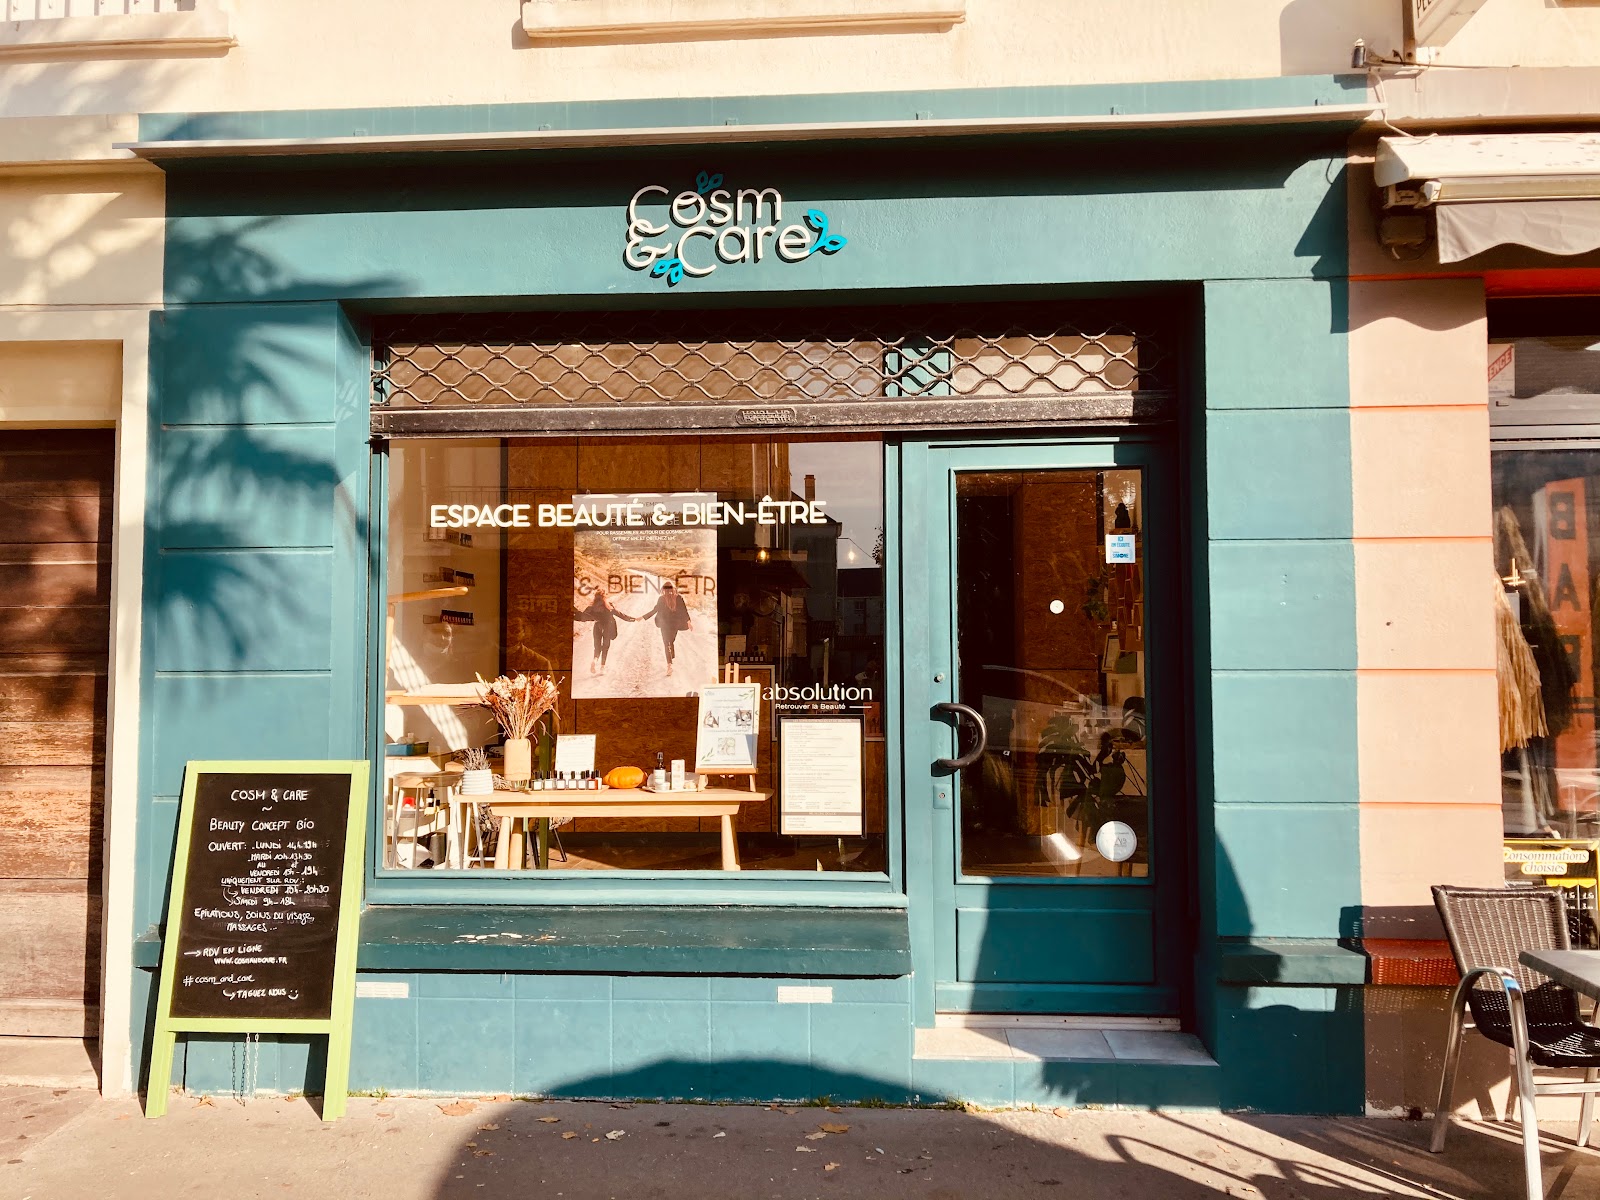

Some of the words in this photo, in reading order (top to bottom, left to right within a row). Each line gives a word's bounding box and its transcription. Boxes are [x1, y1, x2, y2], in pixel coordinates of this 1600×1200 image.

[630, 185, 782, 233] Cosm
[625, 218, 672, 267] &
[677, 224, 811, 275] Care
[430, 503, 531, 528] ESPACE
[538, 497, 646, 528] BEAUTÉ
[652, 503, 675, 527] &
[682, 495, 828, 526] BIEN-ÊTRE
[762, 682, 873, 701] absolution
[230, 790, 266, 801] COSM
[270, 788, 279, 803] &
[283, 789, 309, 801] CARE
[251, 820, 291, 831] CONCEPT
[1524, 861, 1565, 873] choisies
[203, 946, 220, 957] RDV
[223, 947, 235, 955] EN
[236, 990, 266, 999] TAGUEZ
[268, 988, 287, 997] NOUS
